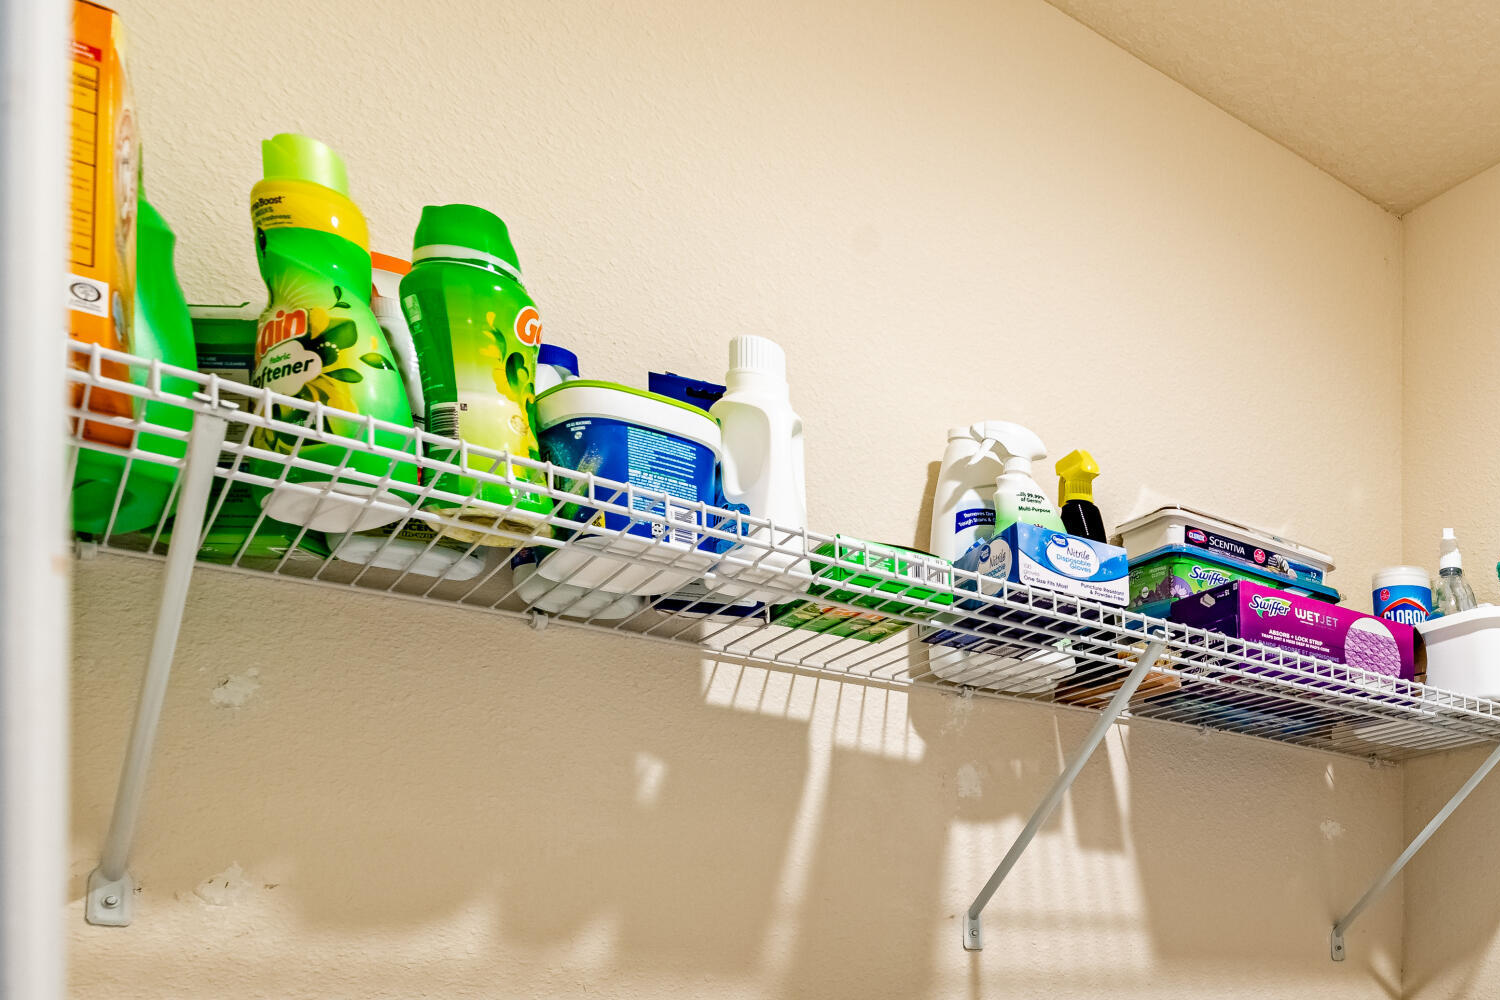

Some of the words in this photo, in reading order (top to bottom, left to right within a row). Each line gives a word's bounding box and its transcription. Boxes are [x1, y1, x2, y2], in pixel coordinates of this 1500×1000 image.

[258, 309, 308, 358] ain
[269, 352, 292, 364] fabric
[252, 358, 315, 388] oftener
[1208, 535, 1246, 555] SCENTIVA
[1056, 553, 1092, 568] Disposable
[1066, 546, 1090, 561] Nitrile
[1070, 563, 1092, 573] Gloves
[1189, 564, 1230, 586] Swiffer
[1310, 571, 1317, 579] 12
[1023, 574, 1034, 582] One
[1080, 582, 1102, 592] Puncture
[1103, 585, 1125, 595] Resistant
[1248, 593, 1291, 619] Swiffer
[1383, 609, 1427, 625] CLOROX
[1268, 628, 1291, 639] ABSORB
[1294, 634, 1309, 643] LOCK
[1308, 638, 1324, 647] STRIP
